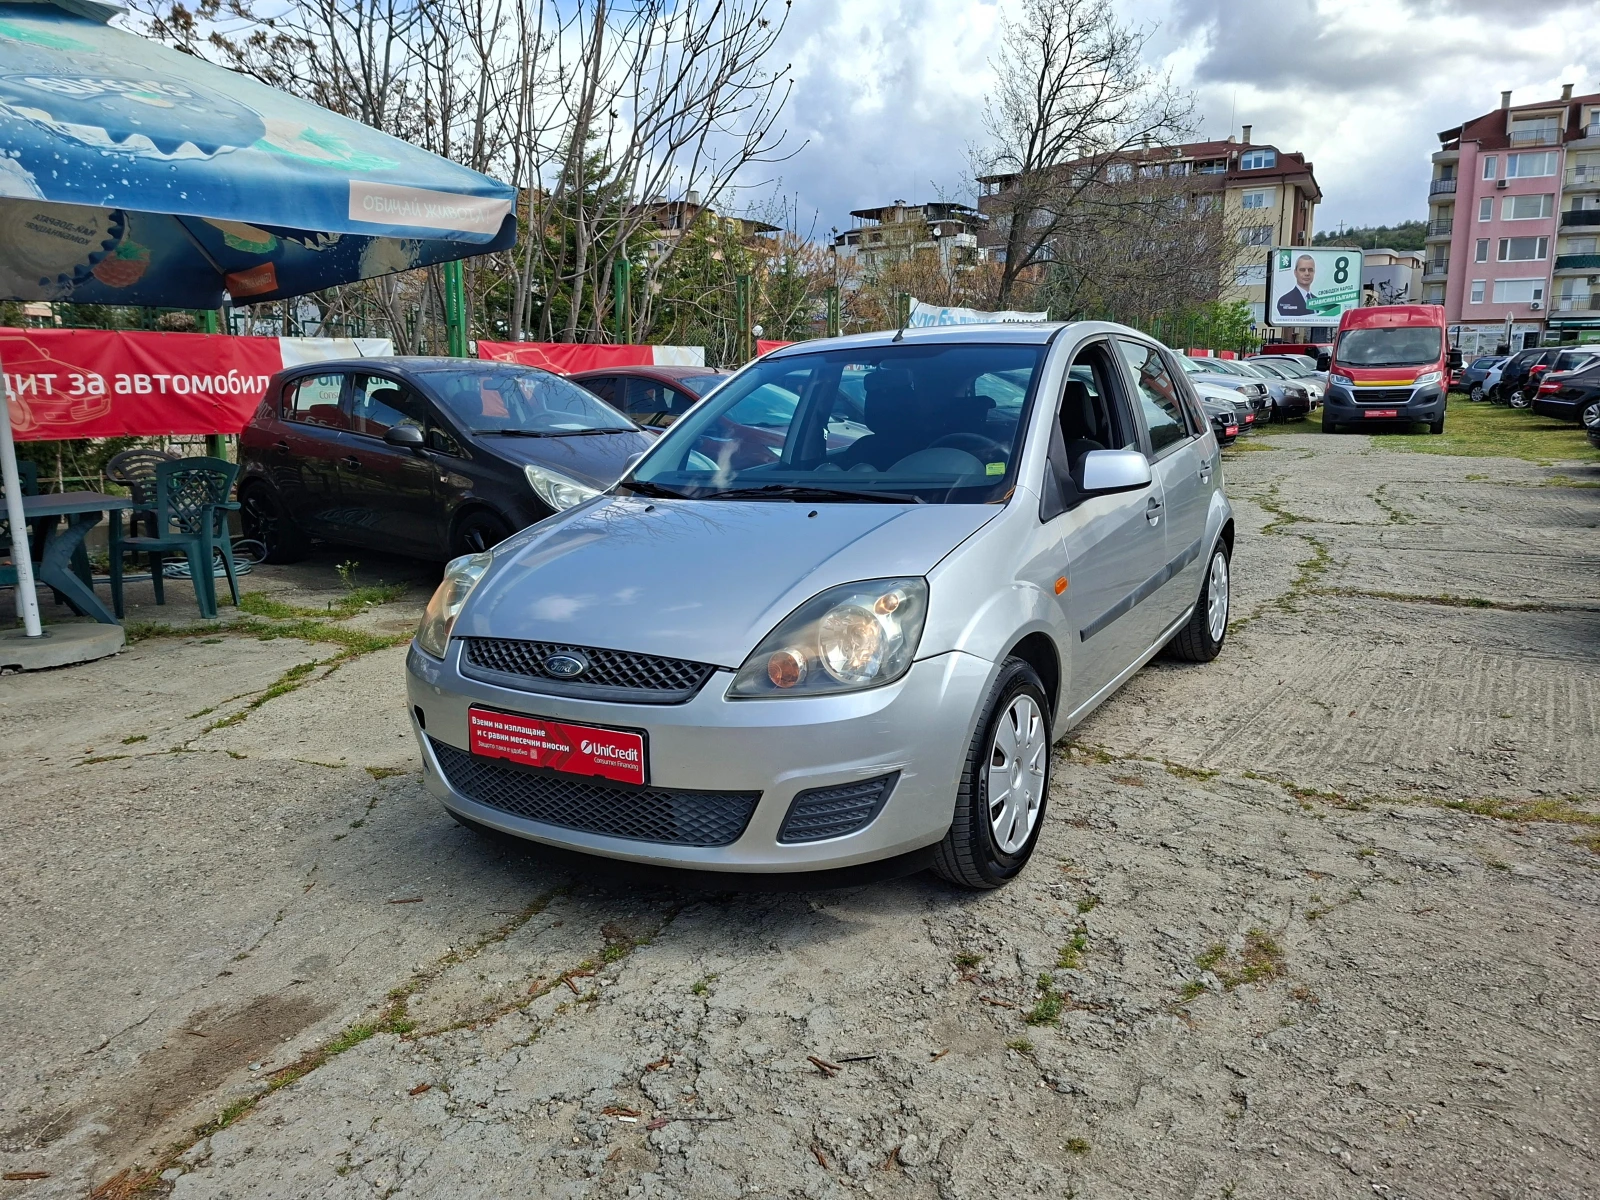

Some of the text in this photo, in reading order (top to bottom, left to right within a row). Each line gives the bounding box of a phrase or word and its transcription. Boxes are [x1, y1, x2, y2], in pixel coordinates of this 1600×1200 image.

[363, 195, 422, 217] ОБИЧАЙ
[1333, 256, 1350, 284] 8
[68, 373, 105, 395] за
[550, 660, 573, 673] Ford
[471, 716, 546, 737] Вземи на изплащане
[488, 731, 509, 742] равни
[510, 735, 541, 747] месечни
[542, 741, 570, 753] вноски
[593, 742, 639, 762] UniCredit
[593, 756, 639, 772] Consumer Financing
